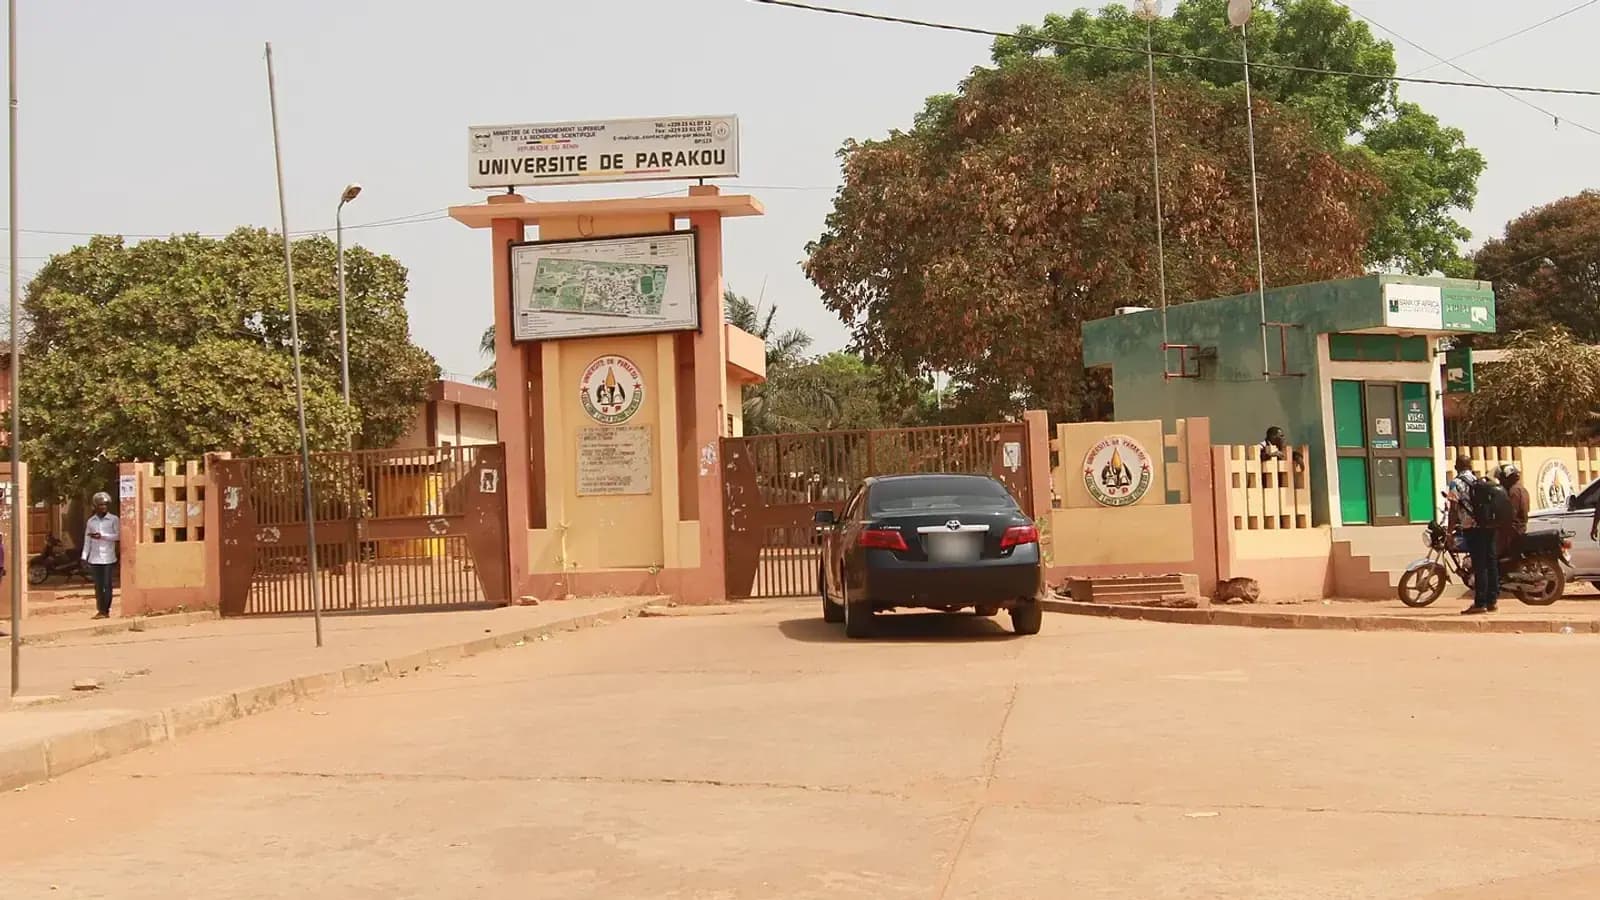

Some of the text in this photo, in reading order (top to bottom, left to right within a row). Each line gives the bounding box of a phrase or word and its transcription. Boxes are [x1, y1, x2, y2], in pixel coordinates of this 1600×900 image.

[478, 149, 726, 175] UNIVERSITE DE PARAKOU
